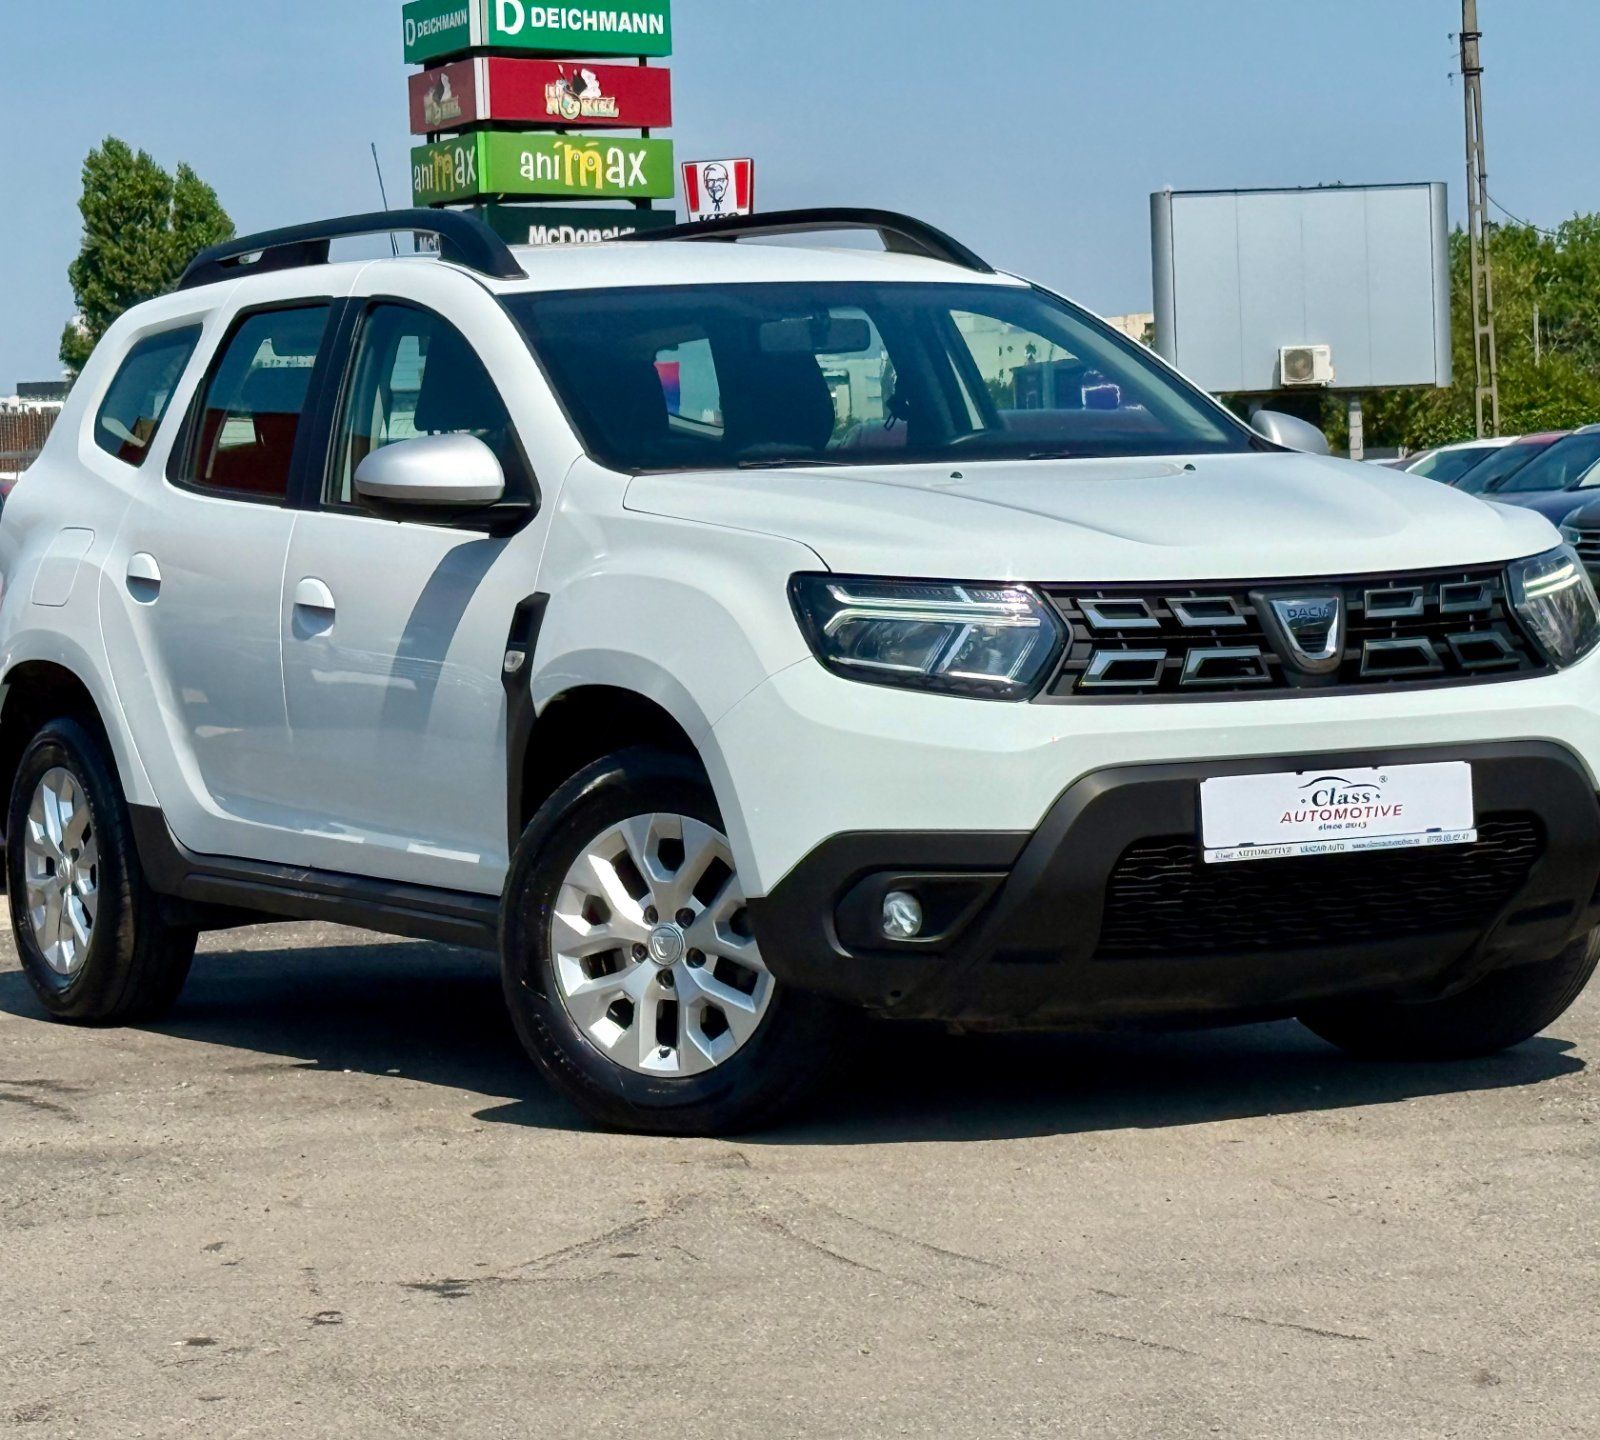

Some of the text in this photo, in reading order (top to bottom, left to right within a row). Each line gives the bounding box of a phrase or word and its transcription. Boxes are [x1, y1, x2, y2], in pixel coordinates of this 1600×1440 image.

[417, 8, 468, 38] DEICHMANN
[530, 6, 664, 35] DEICHMANN
[413, 145, 477, 193] animax
[519, 141, 648, 190] animax
[528, 224, 636, 245] McDonal
[1311, 787, 1371, 808] Class
[1280, 804, 1404, 825] AUTOMOTIVE
